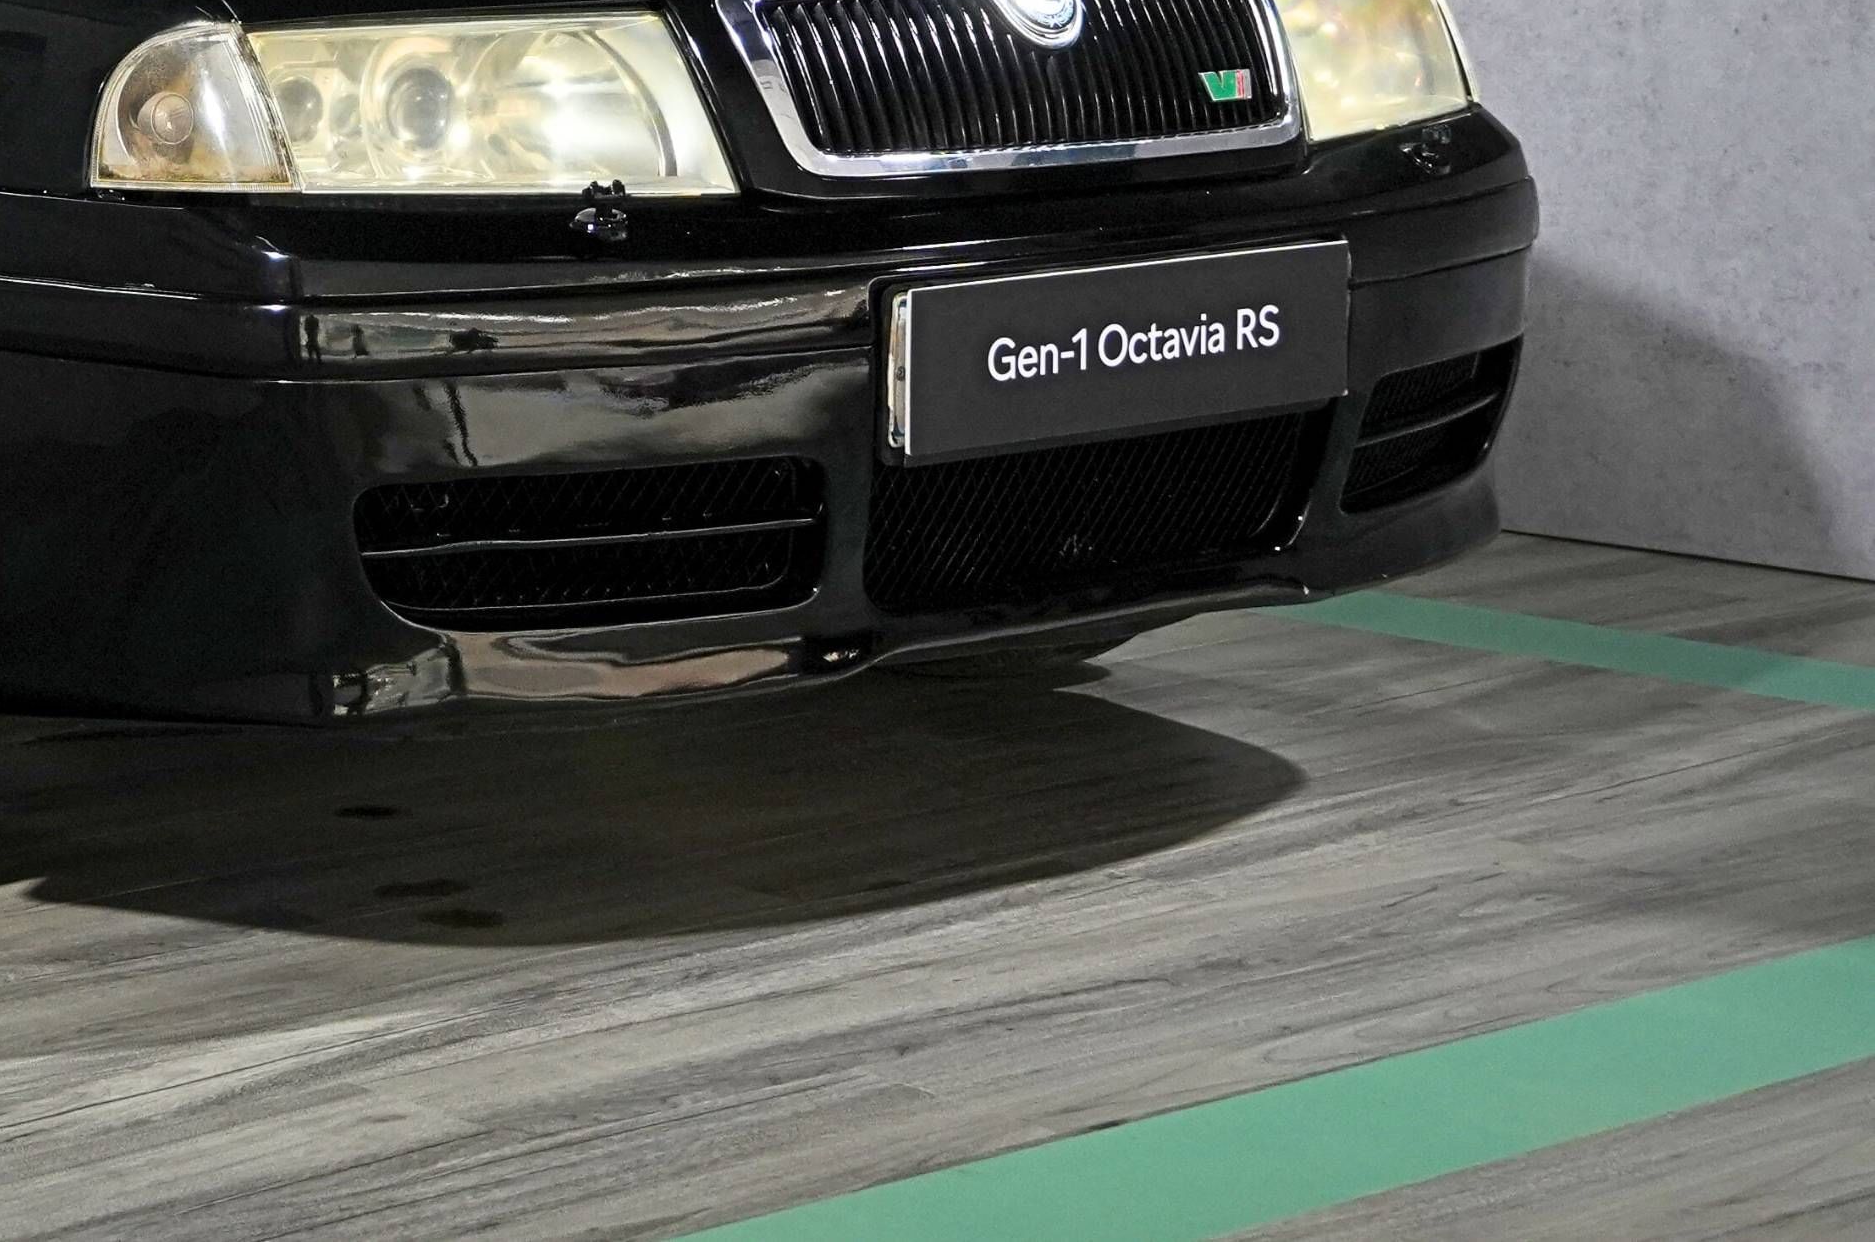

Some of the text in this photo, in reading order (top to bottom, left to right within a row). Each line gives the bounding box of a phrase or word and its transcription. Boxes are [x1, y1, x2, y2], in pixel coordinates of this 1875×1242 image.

[987, 304, 1281, 382] Gen-1 Octavia RS
